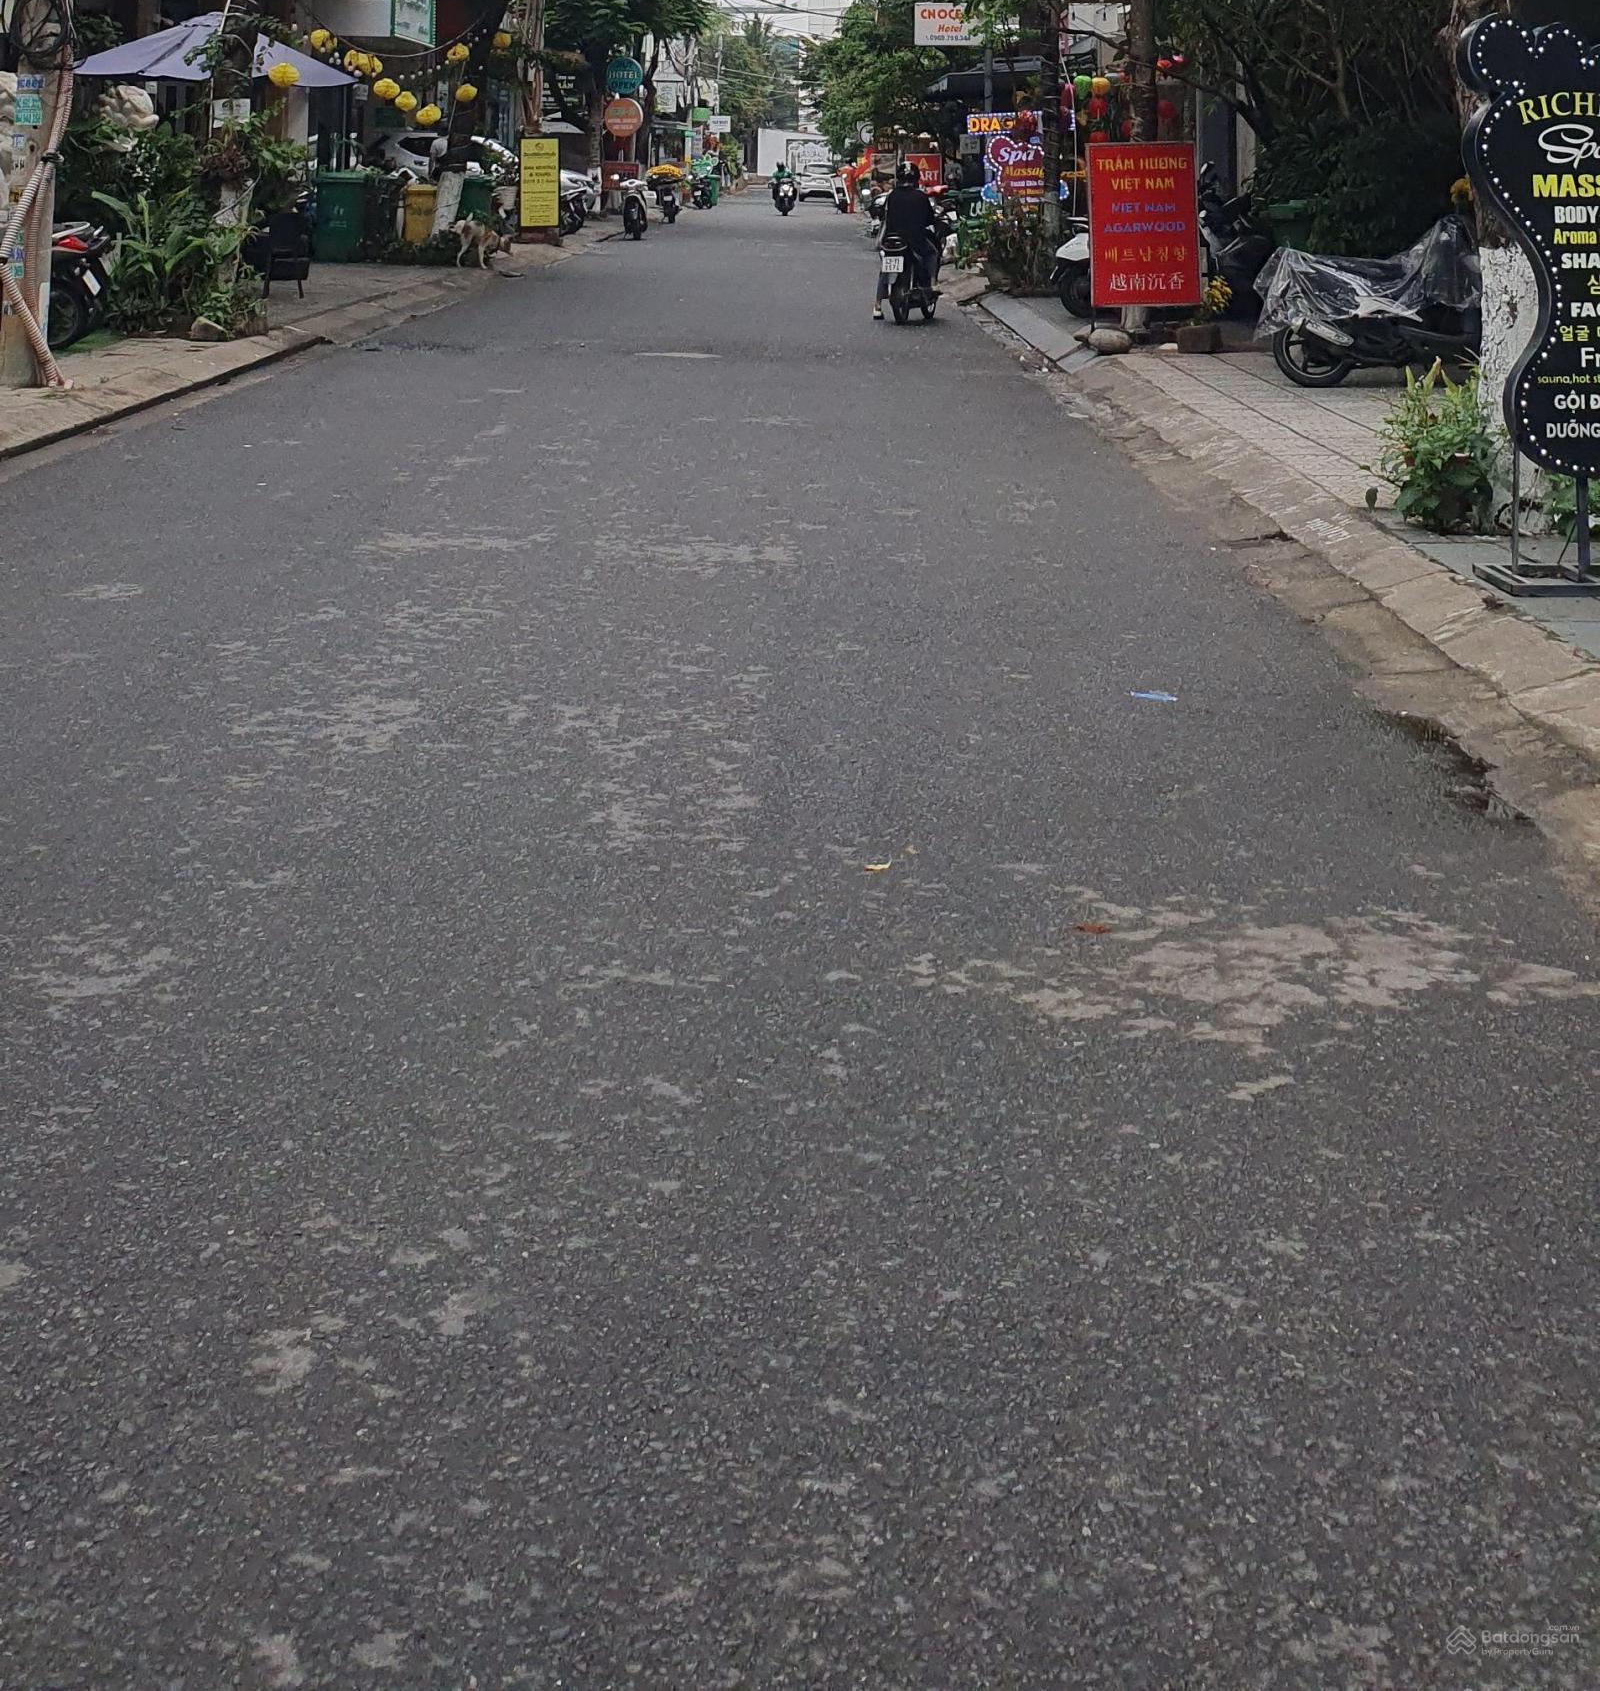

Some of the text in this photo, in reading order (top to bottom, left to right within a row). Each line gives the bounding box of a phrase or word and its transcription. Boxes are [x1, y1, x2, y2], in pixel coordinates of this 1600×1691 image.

[1516, 91, 1600, 125] RICH
[998, 147, 1036, 164] Spa
[1145, 176, 1175, 190] NAM
[1145, 201, 1176, 214] NAM
[1554, 206, 1599, 223] BODY
[1103, 221, 1186, 234] AGARWOOD
[1553, 228, 1597, 244] Aroma
[1109, 271, 1185, 292] 越南沉香
[1571, 302, 1600, 317] FA
[1560, 325, 1590, 341] 얼굴
[1554, 389, 1586, 414] GỘI
